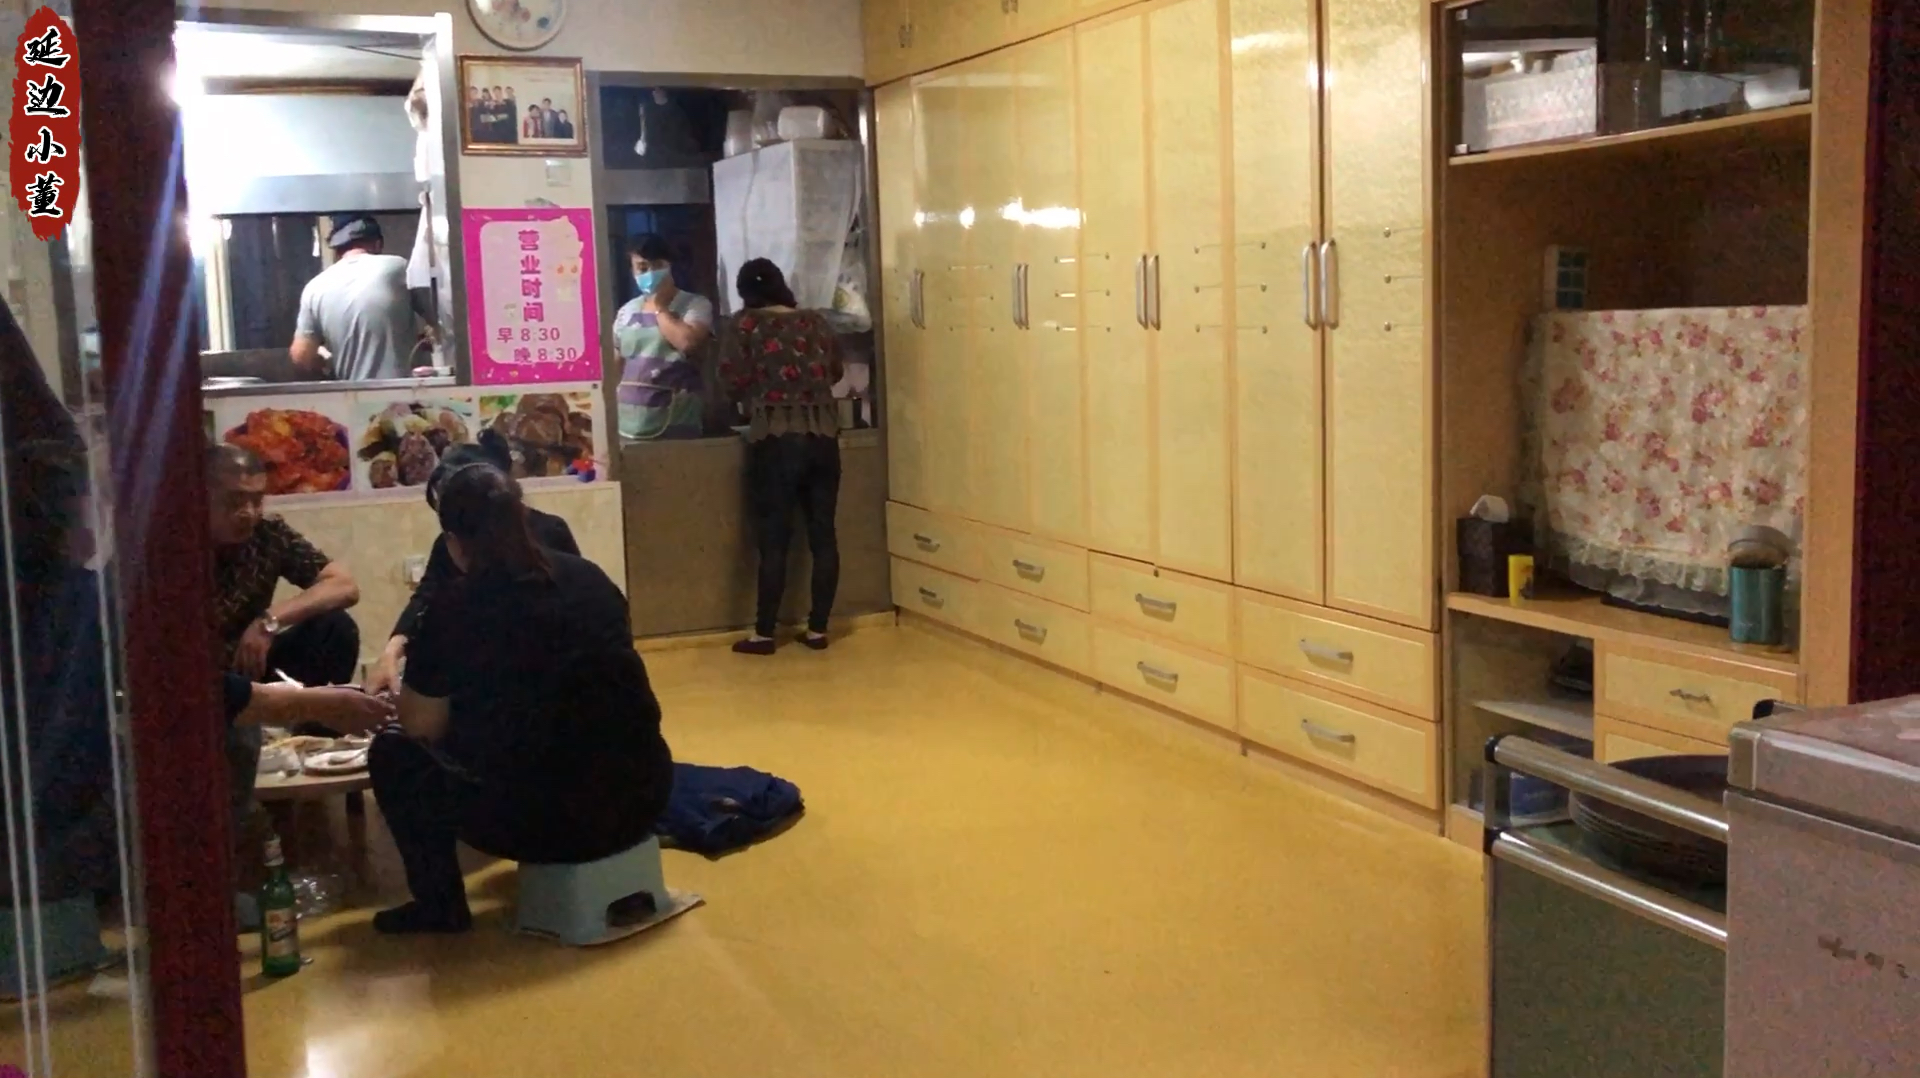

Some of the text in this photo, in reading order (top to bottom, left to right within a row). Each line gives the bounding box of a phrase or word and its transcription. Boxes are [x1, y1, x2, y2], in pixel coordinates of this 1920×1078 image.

[518, 229, 544, 323] 营业时间
[497, 327, 513, 343] 早
[514, 347, 532, 363] 晚
